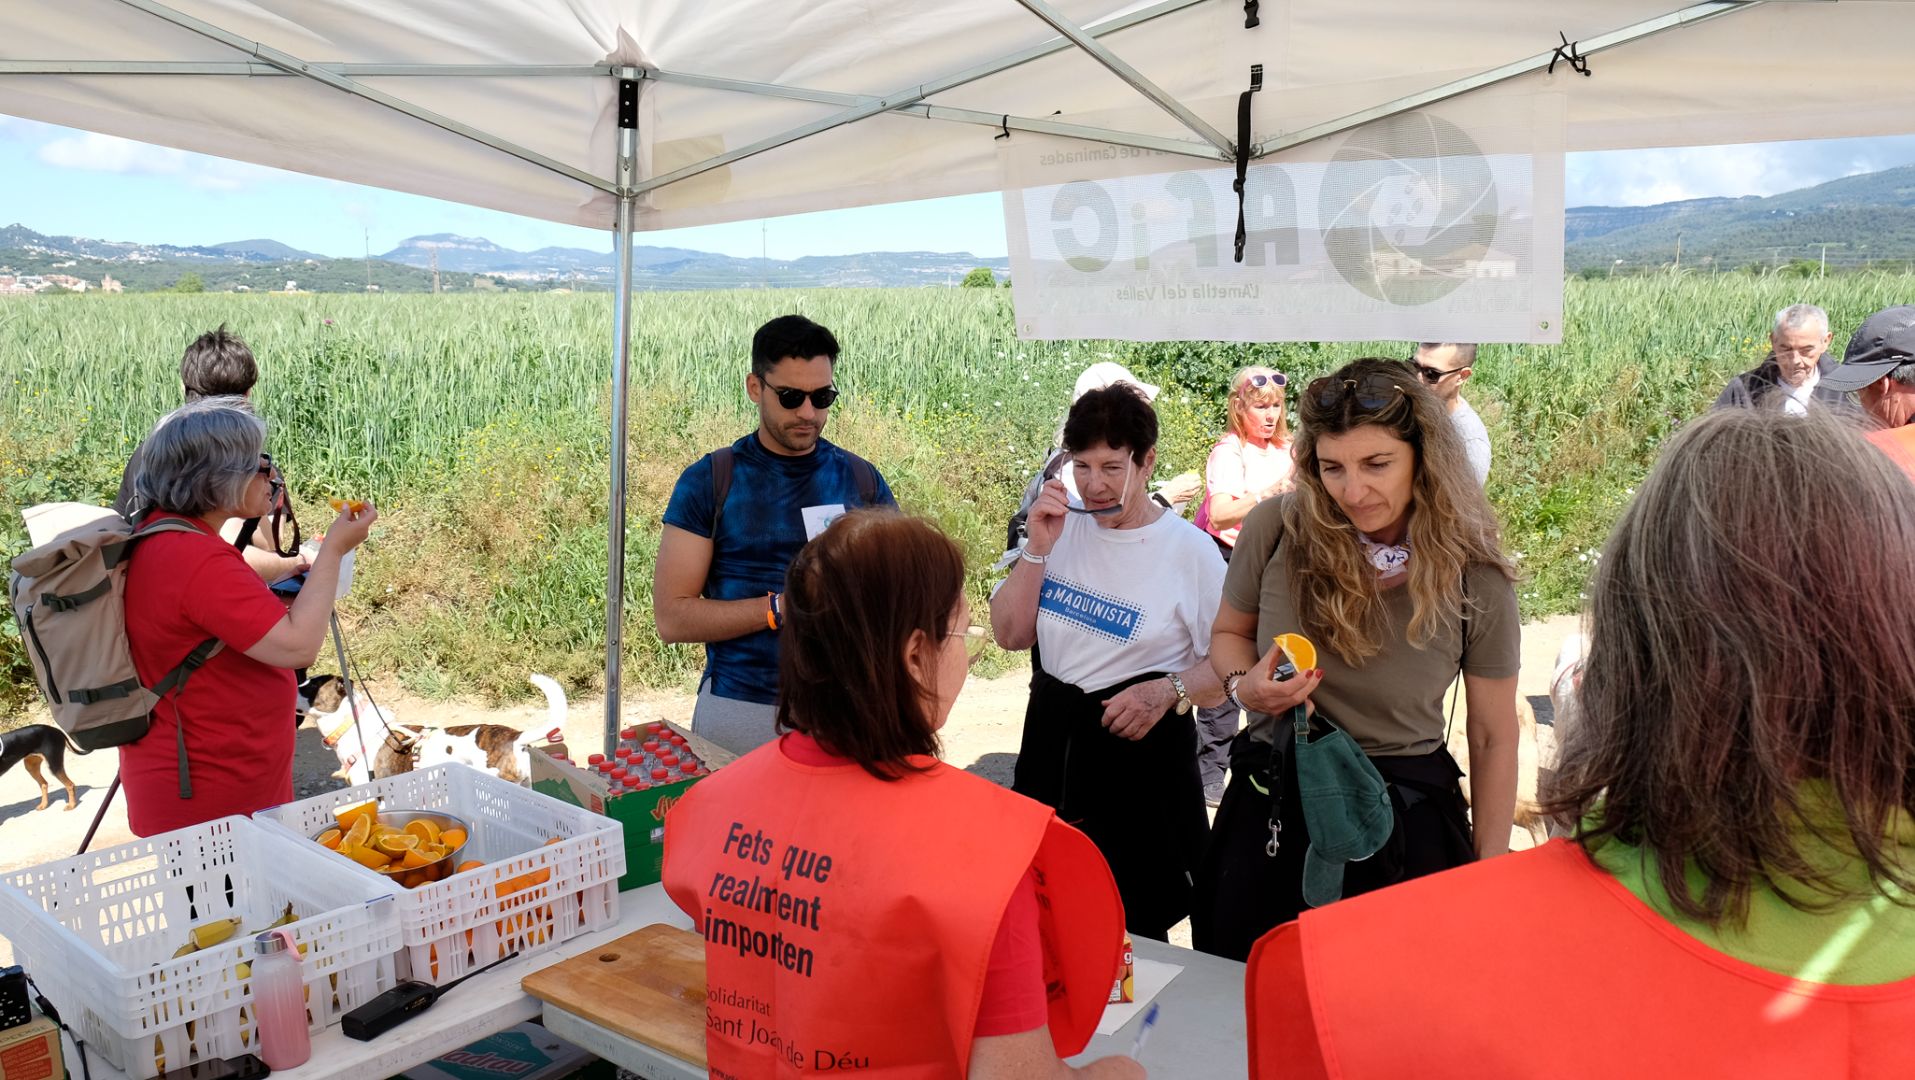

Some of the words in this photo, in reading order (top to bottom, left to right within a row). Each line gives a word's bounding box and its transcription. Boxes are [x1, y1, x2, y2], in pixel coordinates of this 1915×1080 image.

[1053, 587, 1132, 628] MAQUINISTA
[723, 822, 773, 866] Fets
[782, 844, 832, 884] que
[708, 871, 821, 932] realment
[705, 908, 814, 978] importen
[706, 1006, 744, 1040] Sant
[786, 1040, 805, 1070] de
[814, 1050, 869, 1072] Déu
